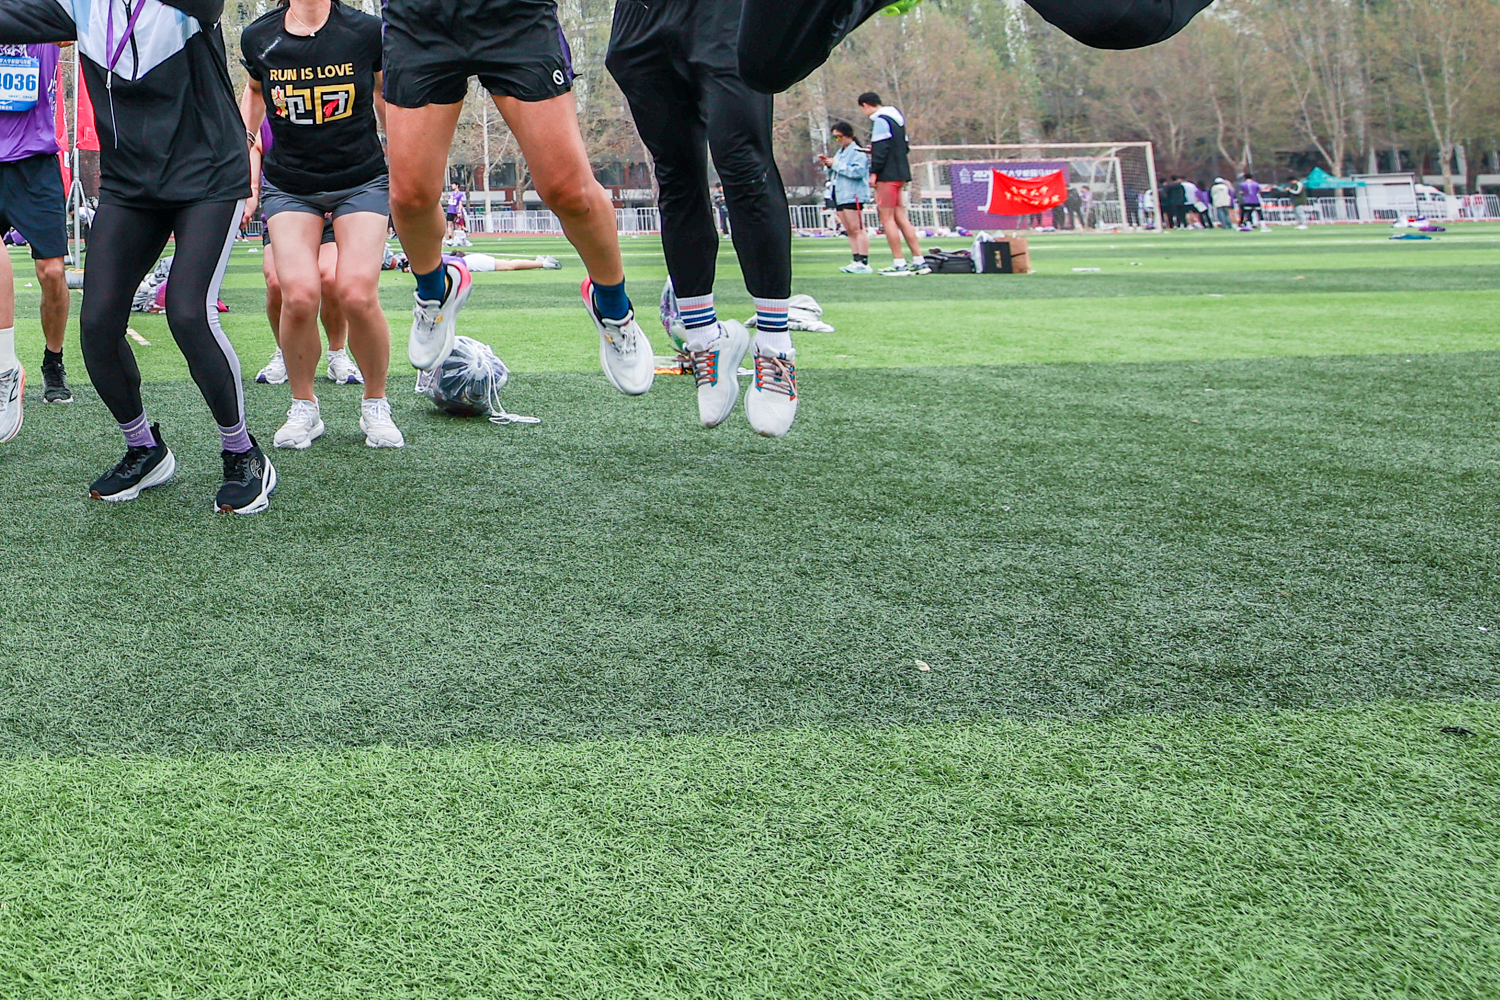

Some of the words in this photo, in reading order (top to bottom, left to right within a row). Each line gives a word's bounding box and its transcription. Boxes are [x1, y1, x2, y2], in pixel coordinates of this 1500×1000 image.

[269, 68, 297, 81] RUN
[300, 67, 314, 80] IS
[316, 62, 355, 79] LOVE
